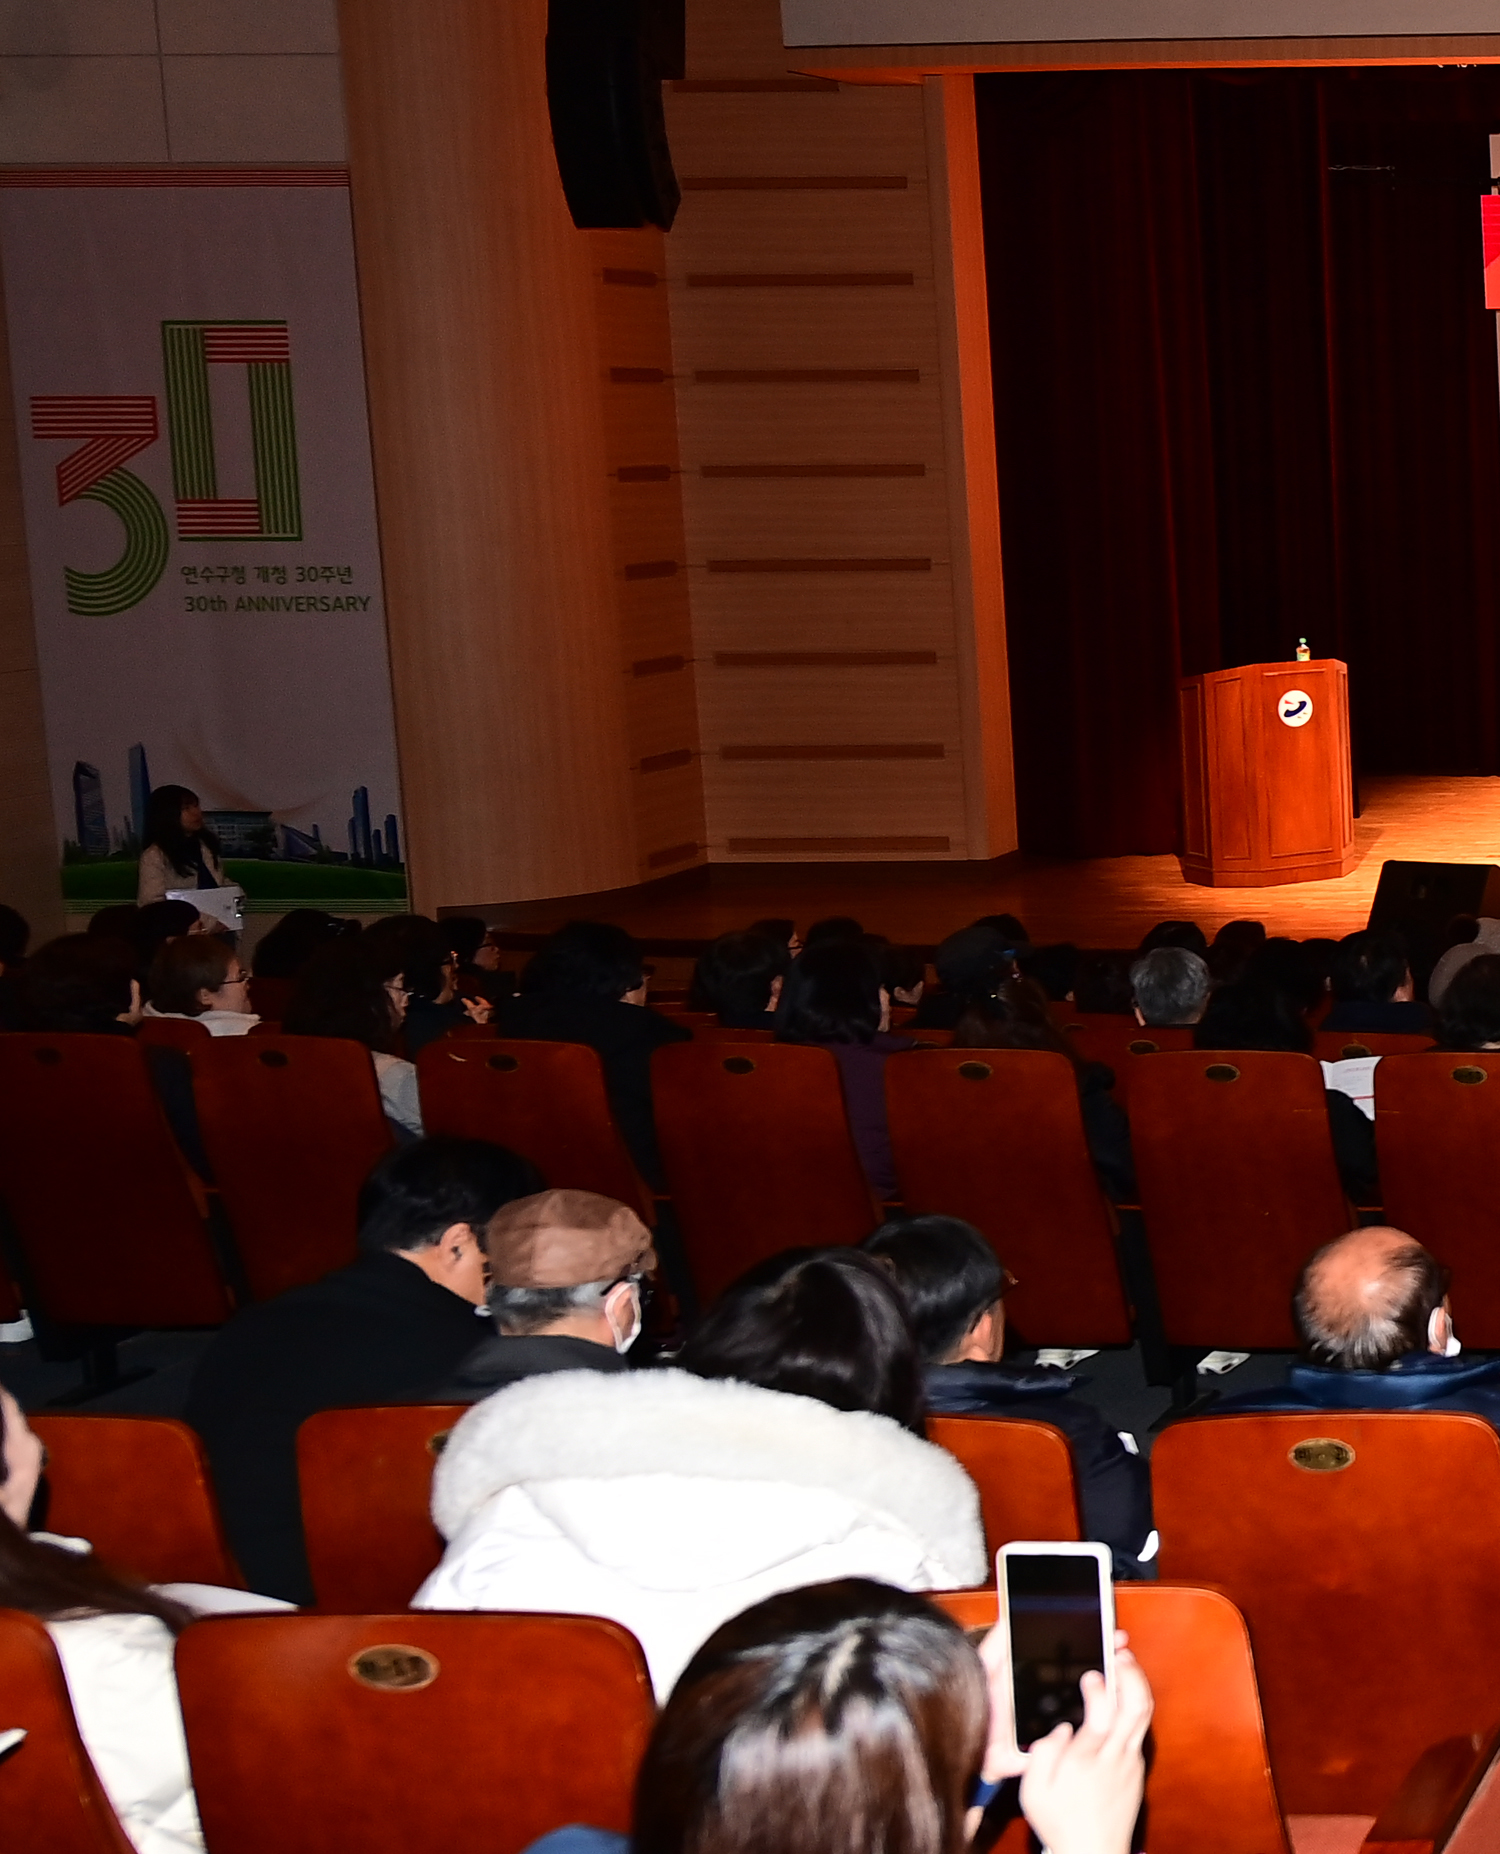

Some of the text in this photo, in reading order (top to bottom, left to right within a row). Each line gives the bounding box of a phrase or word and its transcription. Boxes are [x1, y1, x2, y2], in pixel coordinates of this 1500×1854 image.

[29, 319, 303, 616] 30
[180, 565, 353, 585] 연수구청 개청 30주년
[184, 595, 372, 613] 30th ANNIVERSARY
